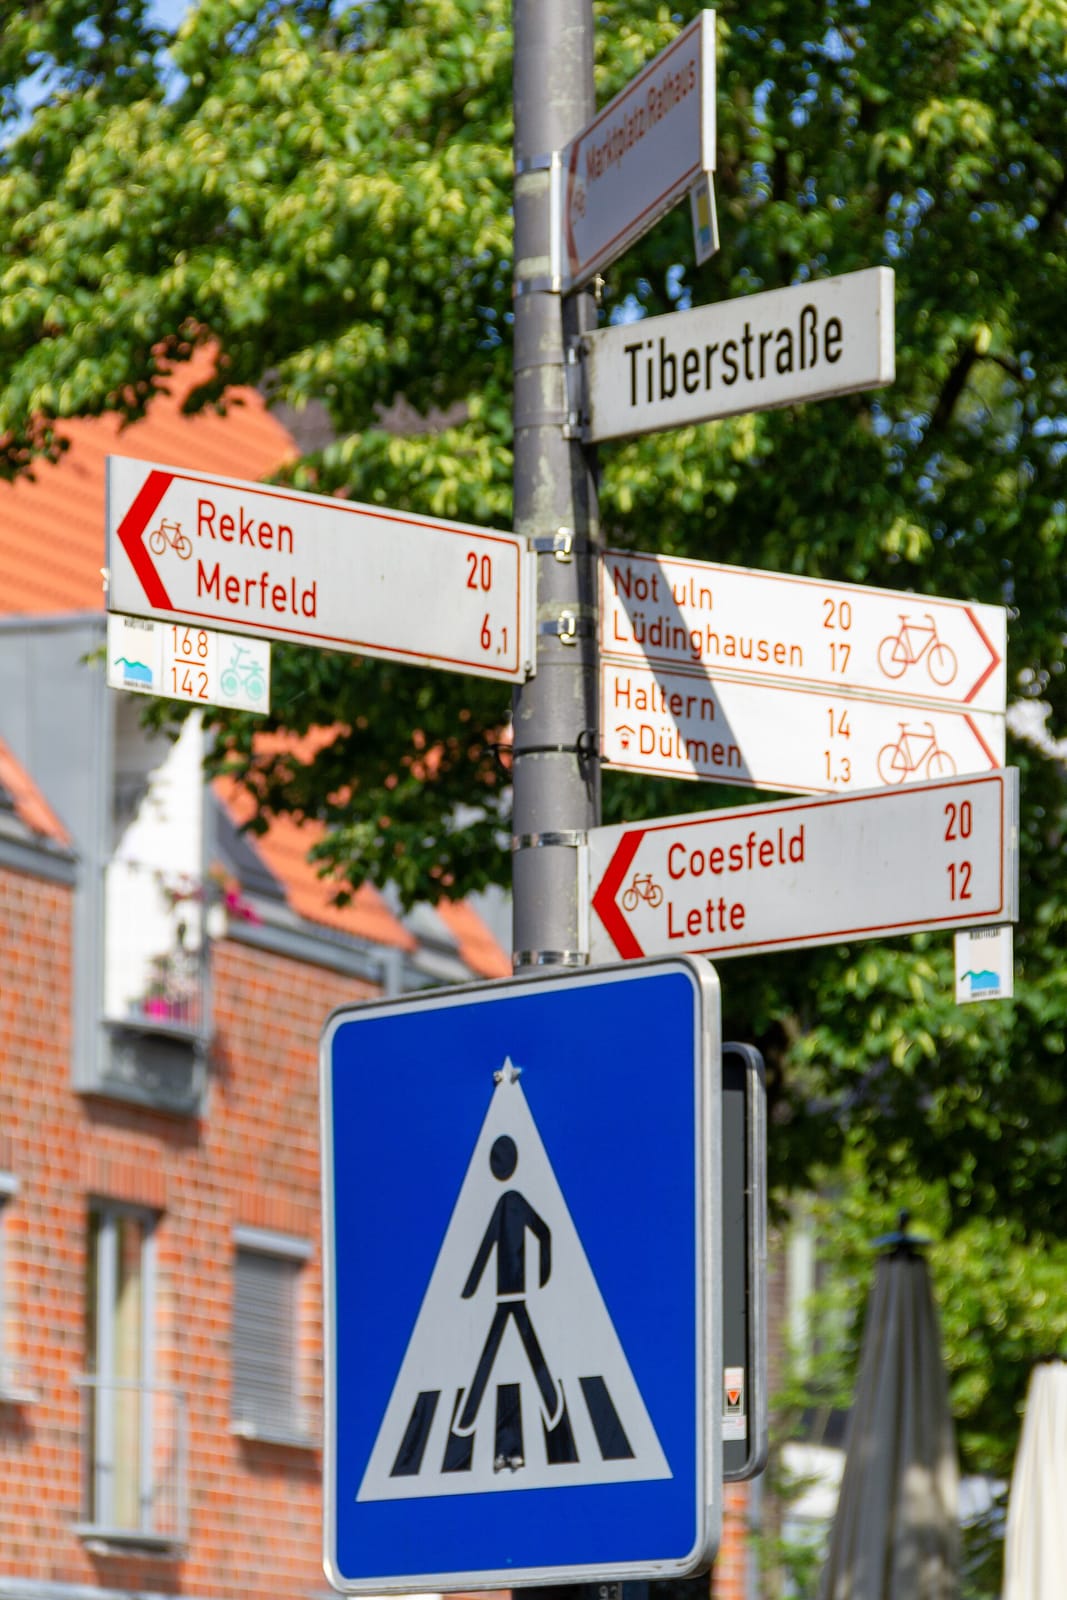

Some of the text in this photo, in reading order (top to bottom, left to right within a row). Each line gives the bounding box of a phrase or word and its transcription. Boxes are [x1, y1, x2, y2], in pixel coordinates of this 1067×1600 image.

[623, 303, 843, 407] Tiberstraße
[197, 498, 492, 592] Reken 20
[197, 559, 509, 656] Merfeld 6,1
[822, 597, 853, 632] 20
[171, 625, 209, 658] 168
[613, 610, 851, 675] Lüdinghausen 17
[171, 667, 209, 699] 142
[614, 676, 851, 740] Haltern 14
[639, 724, 852, 784] Dülmen 1,3
[666, 799, 972, 881] Coesfeld 20
[666, 860, 972, 940] Lette 12
